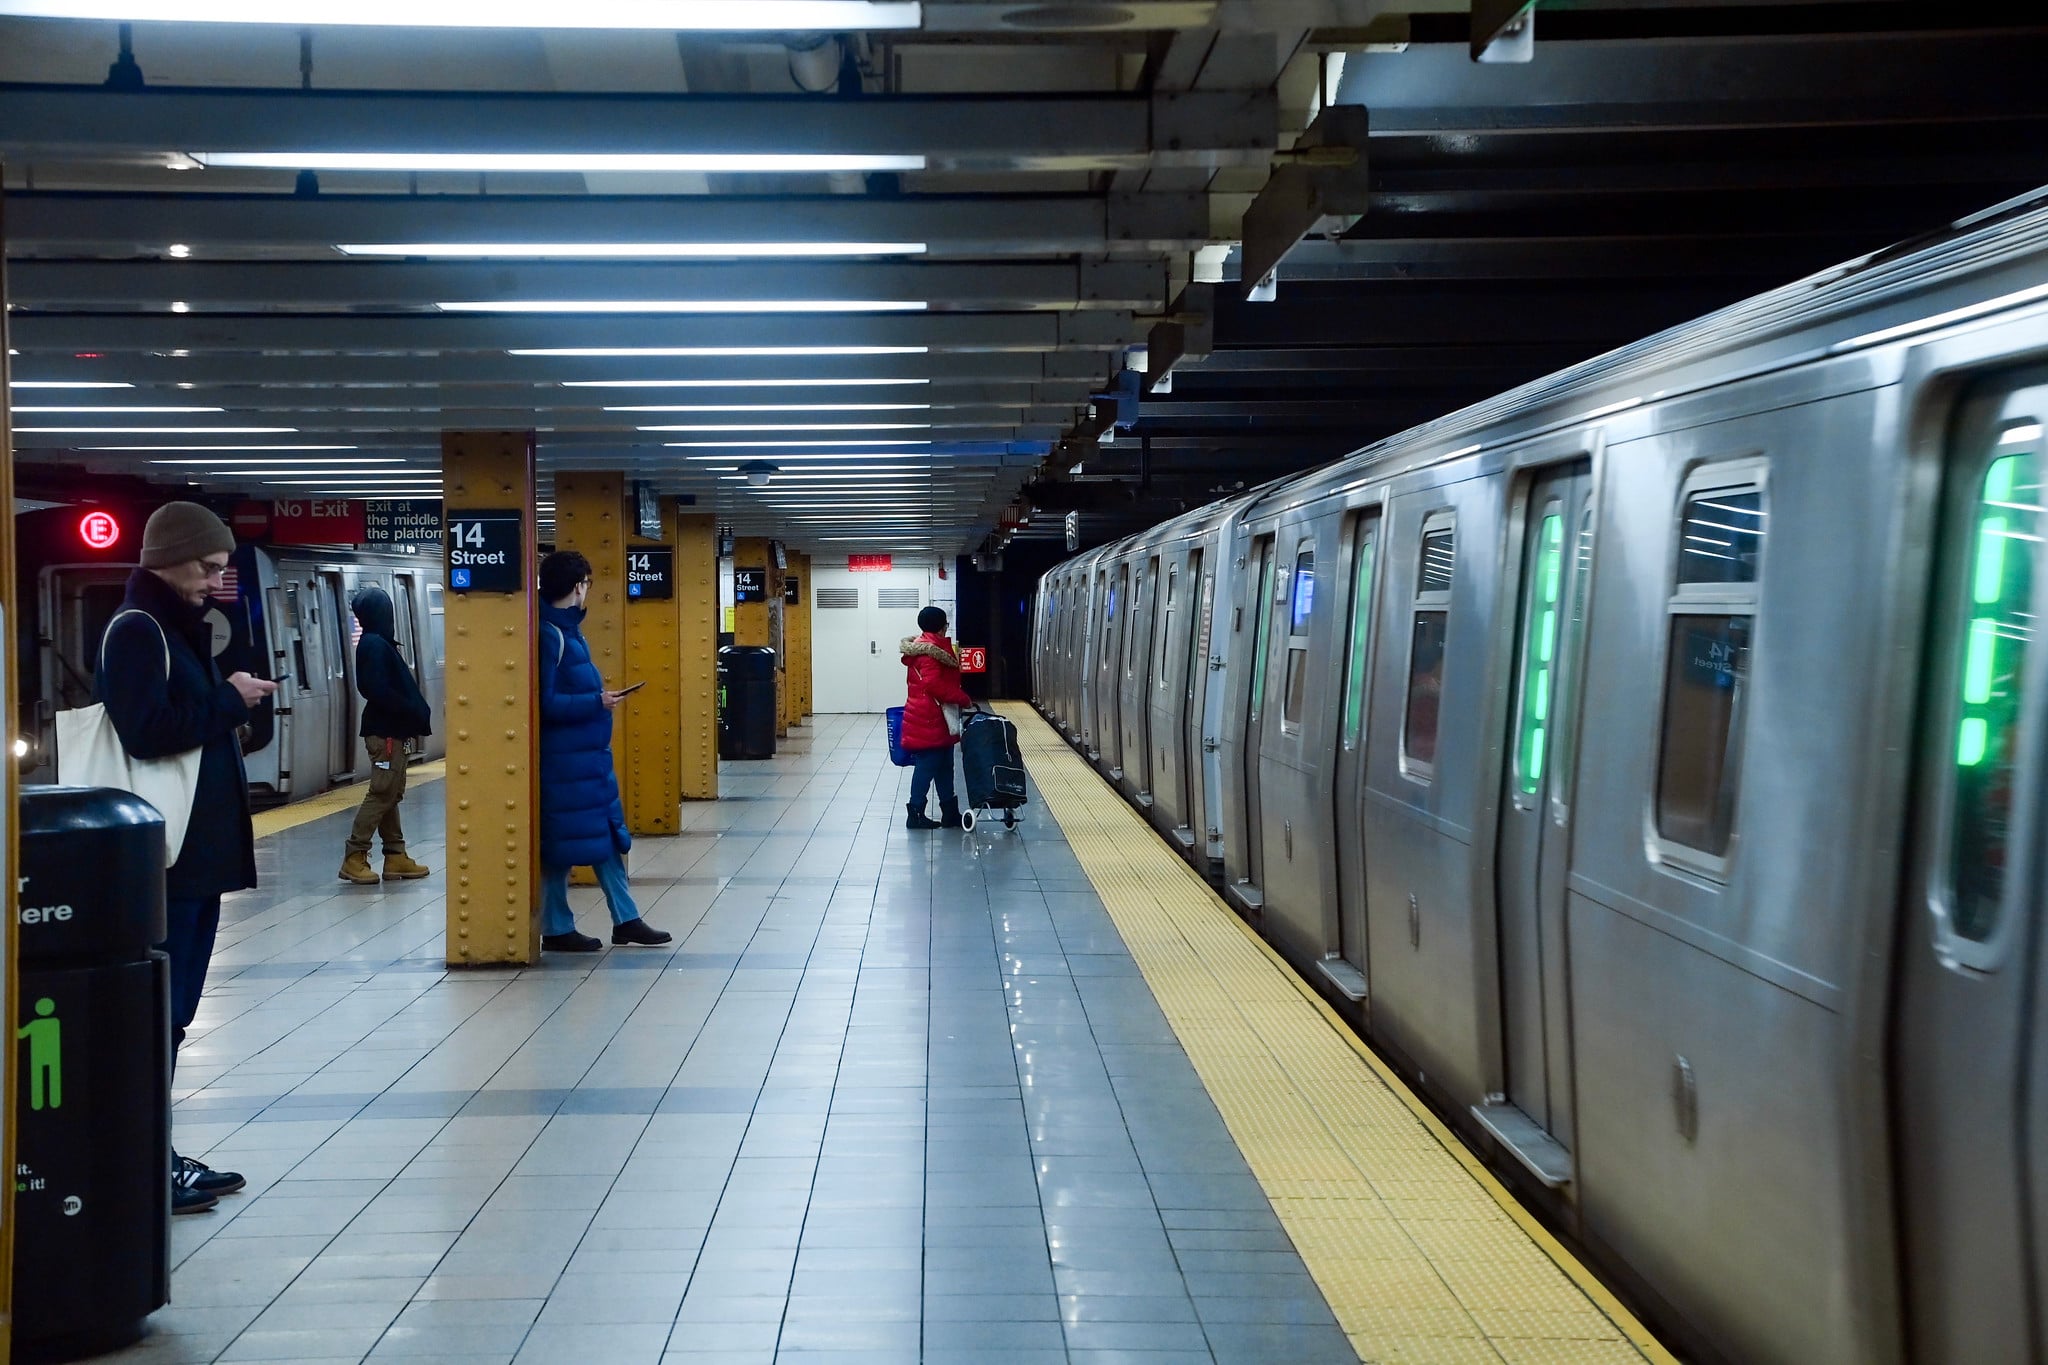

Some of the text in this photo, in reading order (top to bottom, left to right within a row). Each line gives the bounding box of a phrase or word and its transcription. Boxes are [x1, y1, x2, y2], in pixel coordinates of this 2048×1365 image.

[275, 499, 350, 517] No Exit
[366, 500, 411, 512] Exit at
[367, 513, 439, 526] the middle
[367, 527, 389, 539] the
[450, 522, 486, 548] 14
[450, 549, 506, 565] Street
[628, 554, 650, 571] 14
[628, 571, 663, 582] Street
[736, 573, 751, 584] 14
[736, 584, 759, 592] Street
[17, 1163, 32, 1175] it.
[30, 1178, 45, 1190] it!
